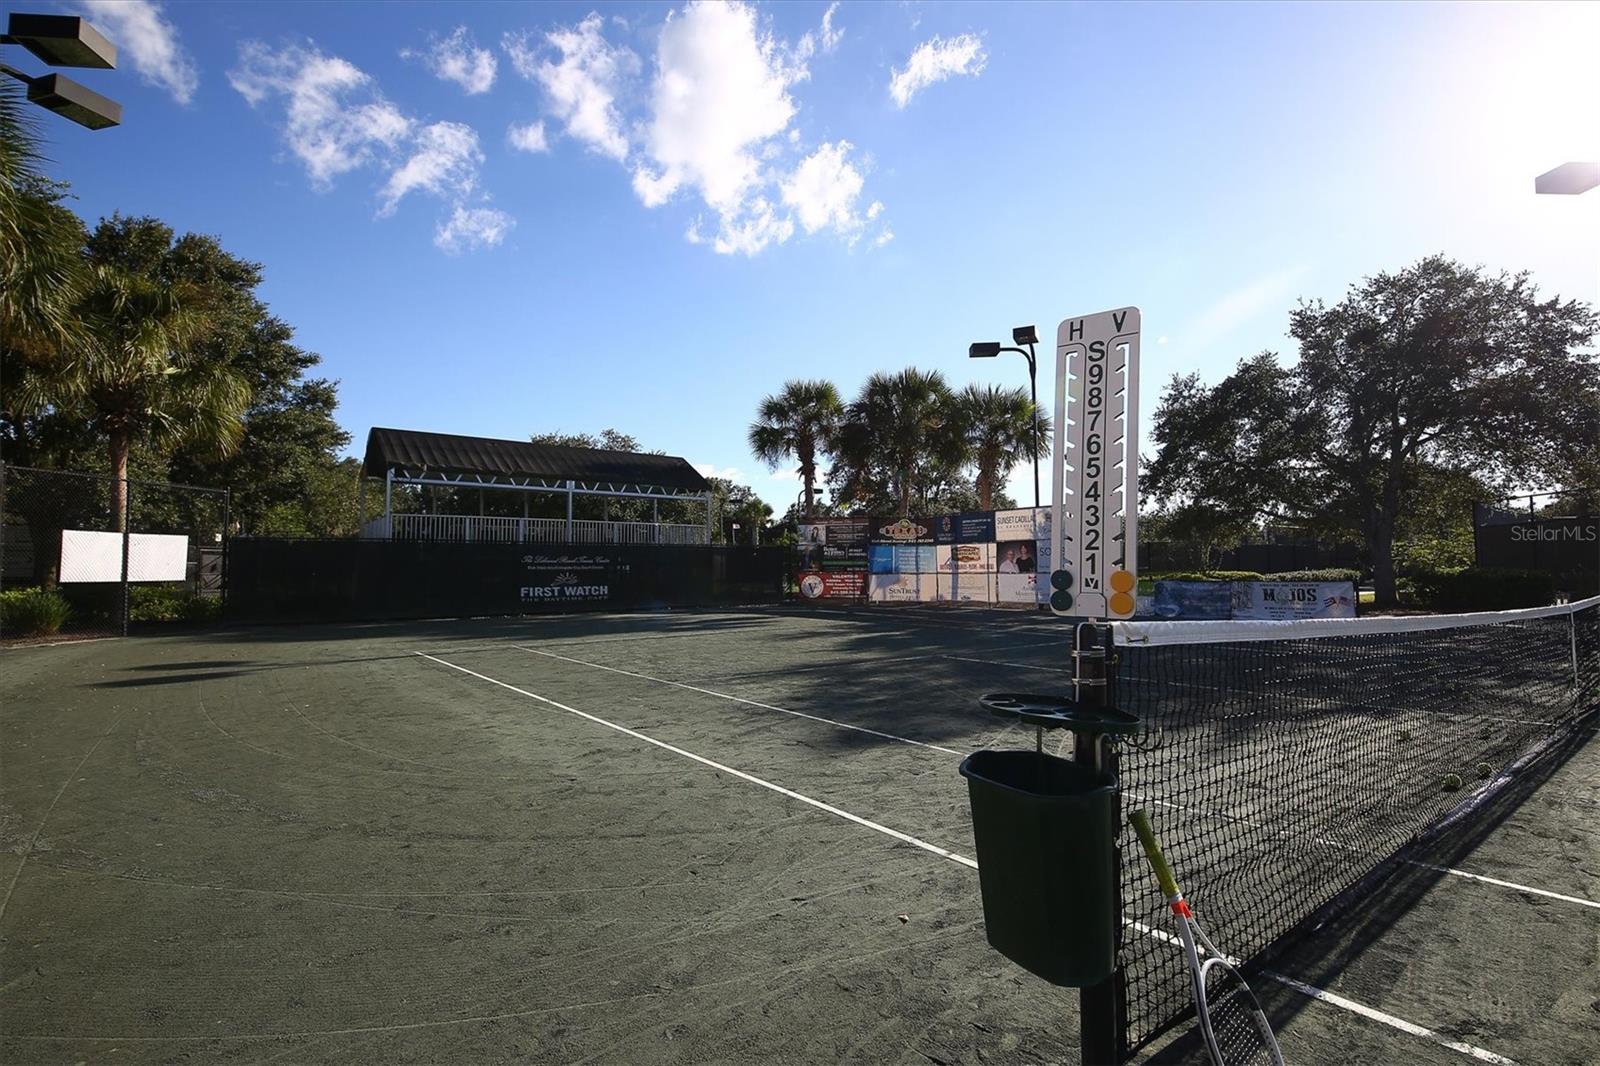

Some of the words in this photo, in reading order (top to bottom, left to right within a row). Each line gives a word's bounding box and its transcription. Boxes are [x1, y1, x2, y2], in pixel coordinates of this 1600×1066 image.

[1069, 319, 1083, 341] H
[1112, 311, 1127, 333] V
[1087, 340, 1105, 362] S
[1088, 364, 1103, 385] 9
[1087, 387, 1102, 408] 8
[1087, 410, 1102, 431] 7
[1086, 433, 1101, 455] 6
[1086, 457, 1101, 479] 5
[1085, 481, 1101, 502] 4
[997, 516, 1014, 525] SUNSET
[1085, 505, 1100, 527] 3
[1085, 529, 1099, 550] 2
[1085, 552, 1096, 575] 1
[520, 586, 560, 597] FIRST
[564, 585, 608, 596] WATCH
